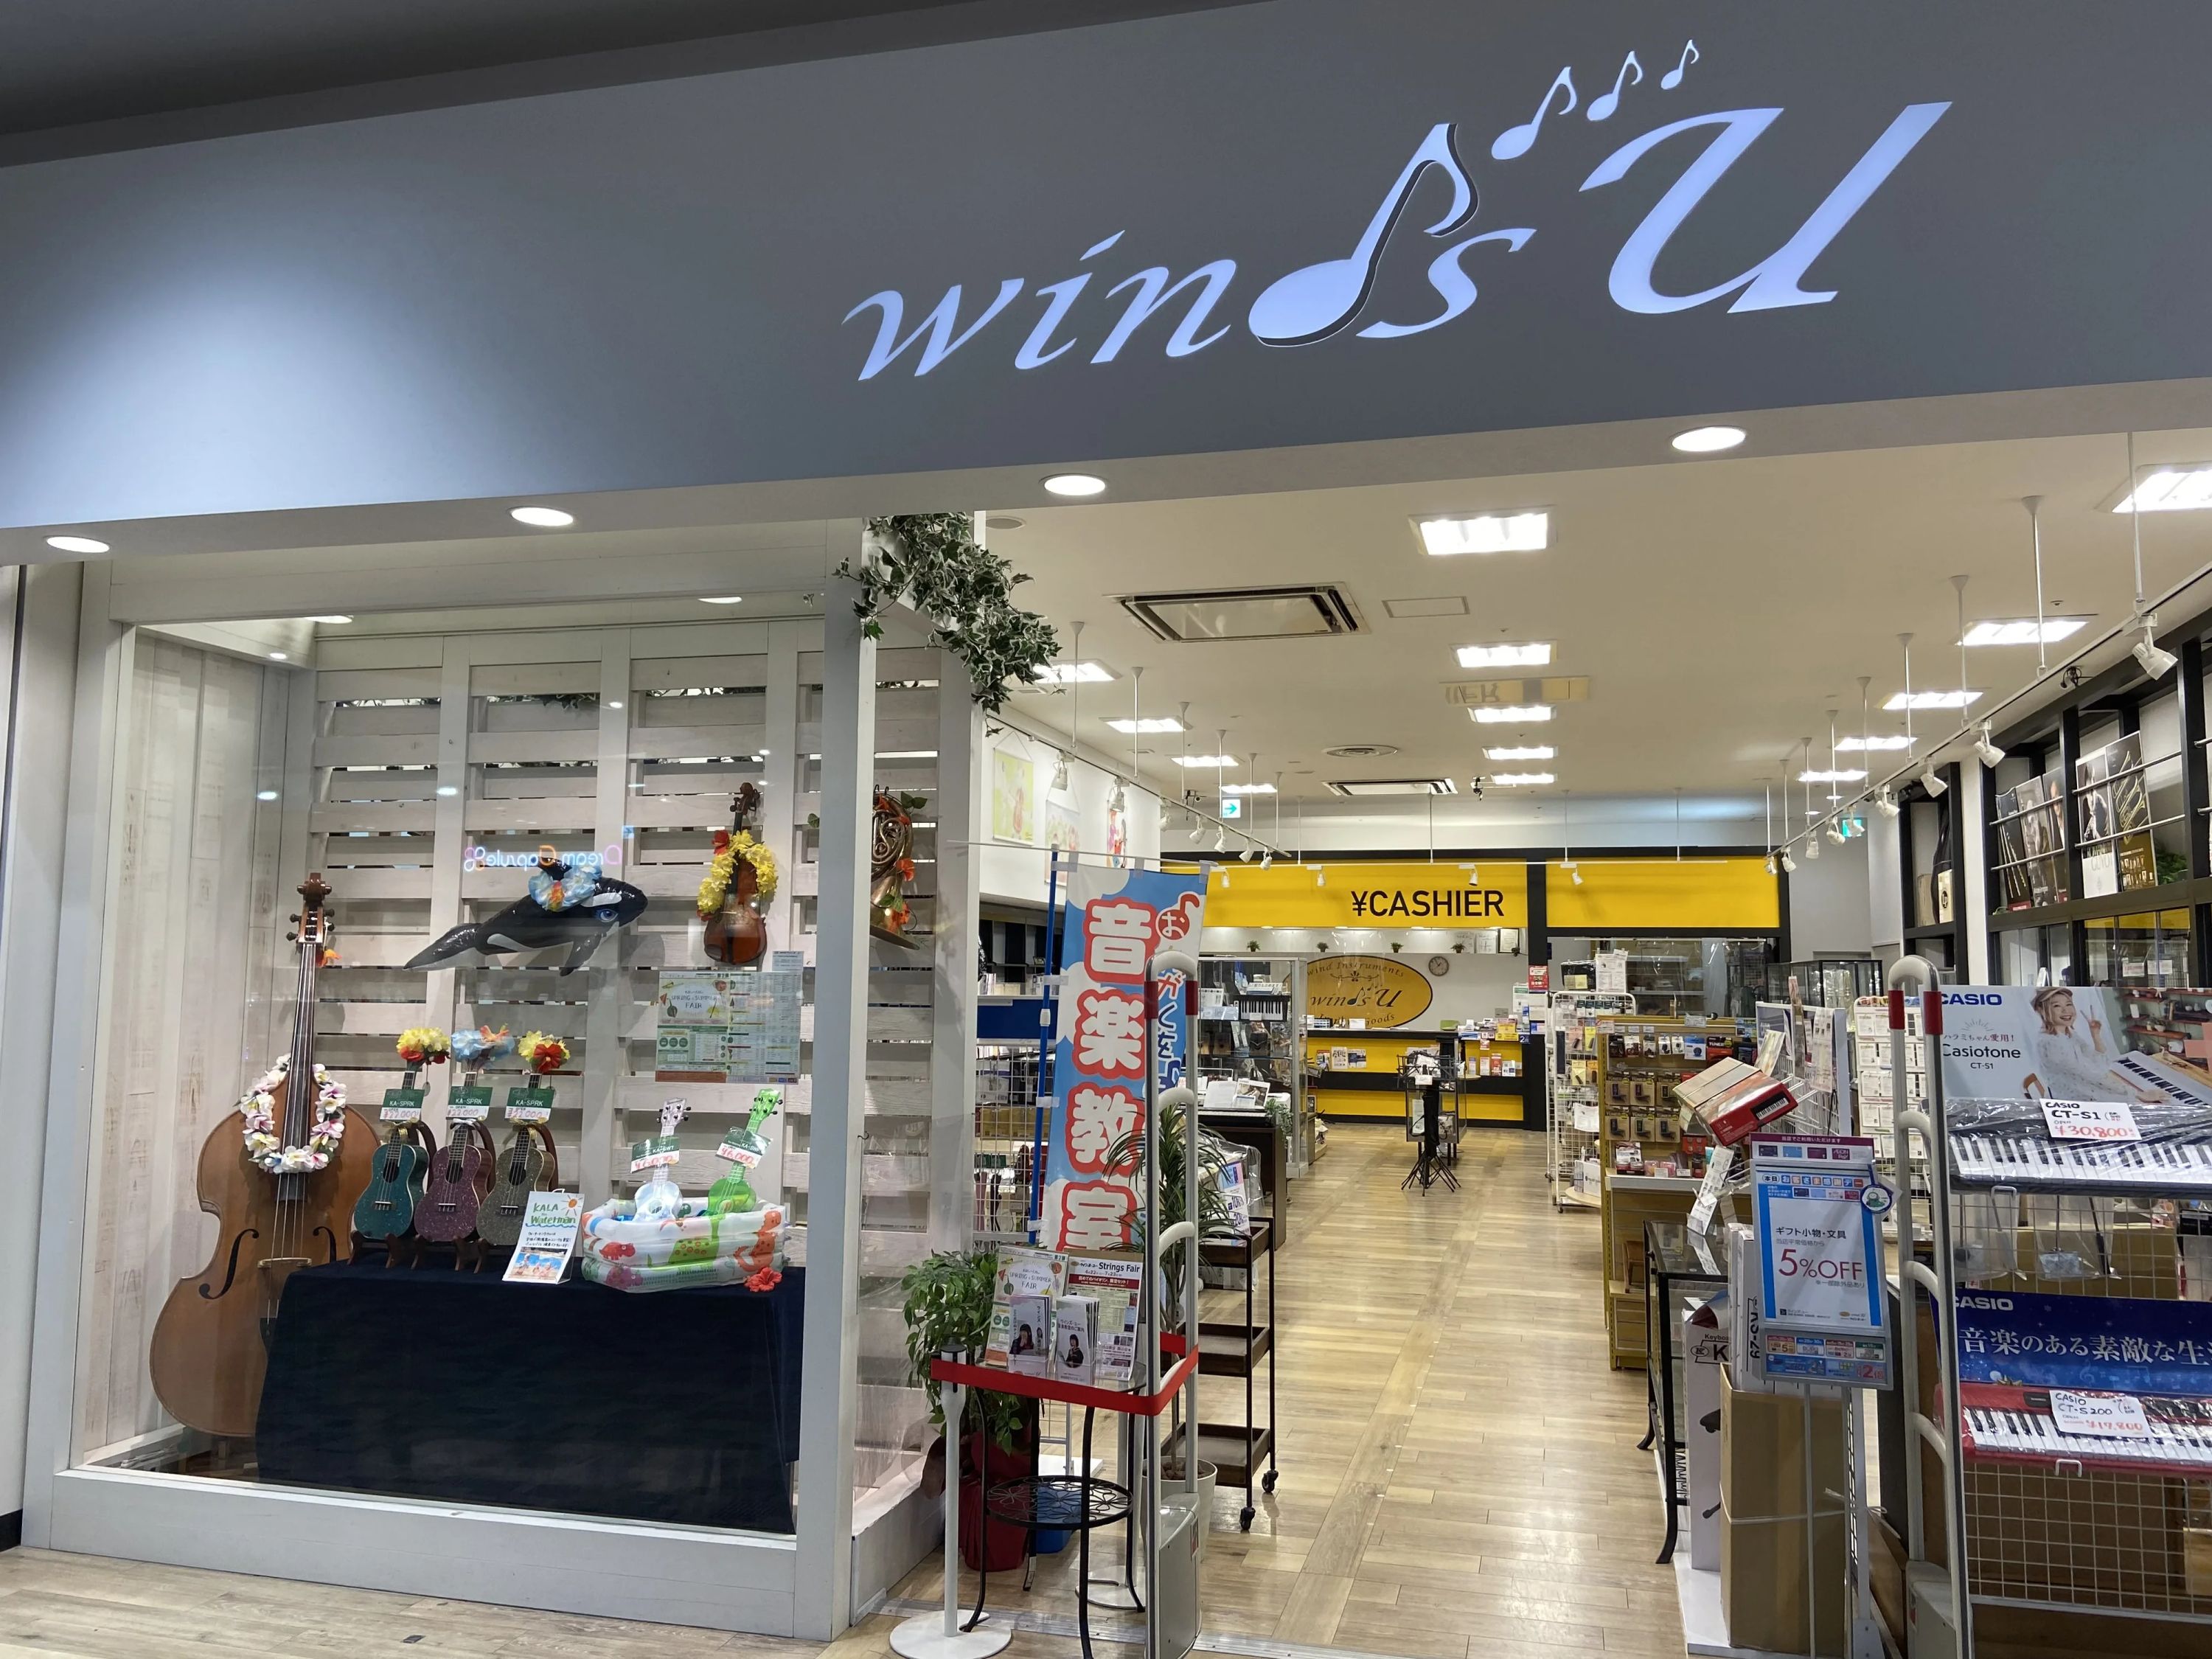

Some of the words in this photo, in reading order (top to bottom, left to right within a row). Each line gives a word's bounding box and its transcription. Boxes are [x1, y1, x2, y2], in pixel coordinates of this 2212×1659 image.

[1579, 101, 1952, 314] U
[1351, 890, 1505, 917] ¥CASHIER
[1337, 961, 1404, 978] Instruments
[1374, 988, 1402, 1007] U
[2051, 1110, 2101, 1120] CT-S1
[1781, 1135, 1841, 1144] 当店でご利用いただけます
[533, 1203, 558, 1213] KALA
[531, 1215, 576, 1225] Waterman
[1775, 1226, 1847, 1239] ギフト小物・文具
[1099, 1262, 1124, 1273] Strings
[1126, 1264, 1141, 1273] Fair
[1778, 1248, 1863, 1280] 5%OFF
[1021, 1281, 1037, 1290] FAIR
[2056, 1393, 2086, 1405] CASIO
[2059, 1403, 2112, 1415] CT-S200
